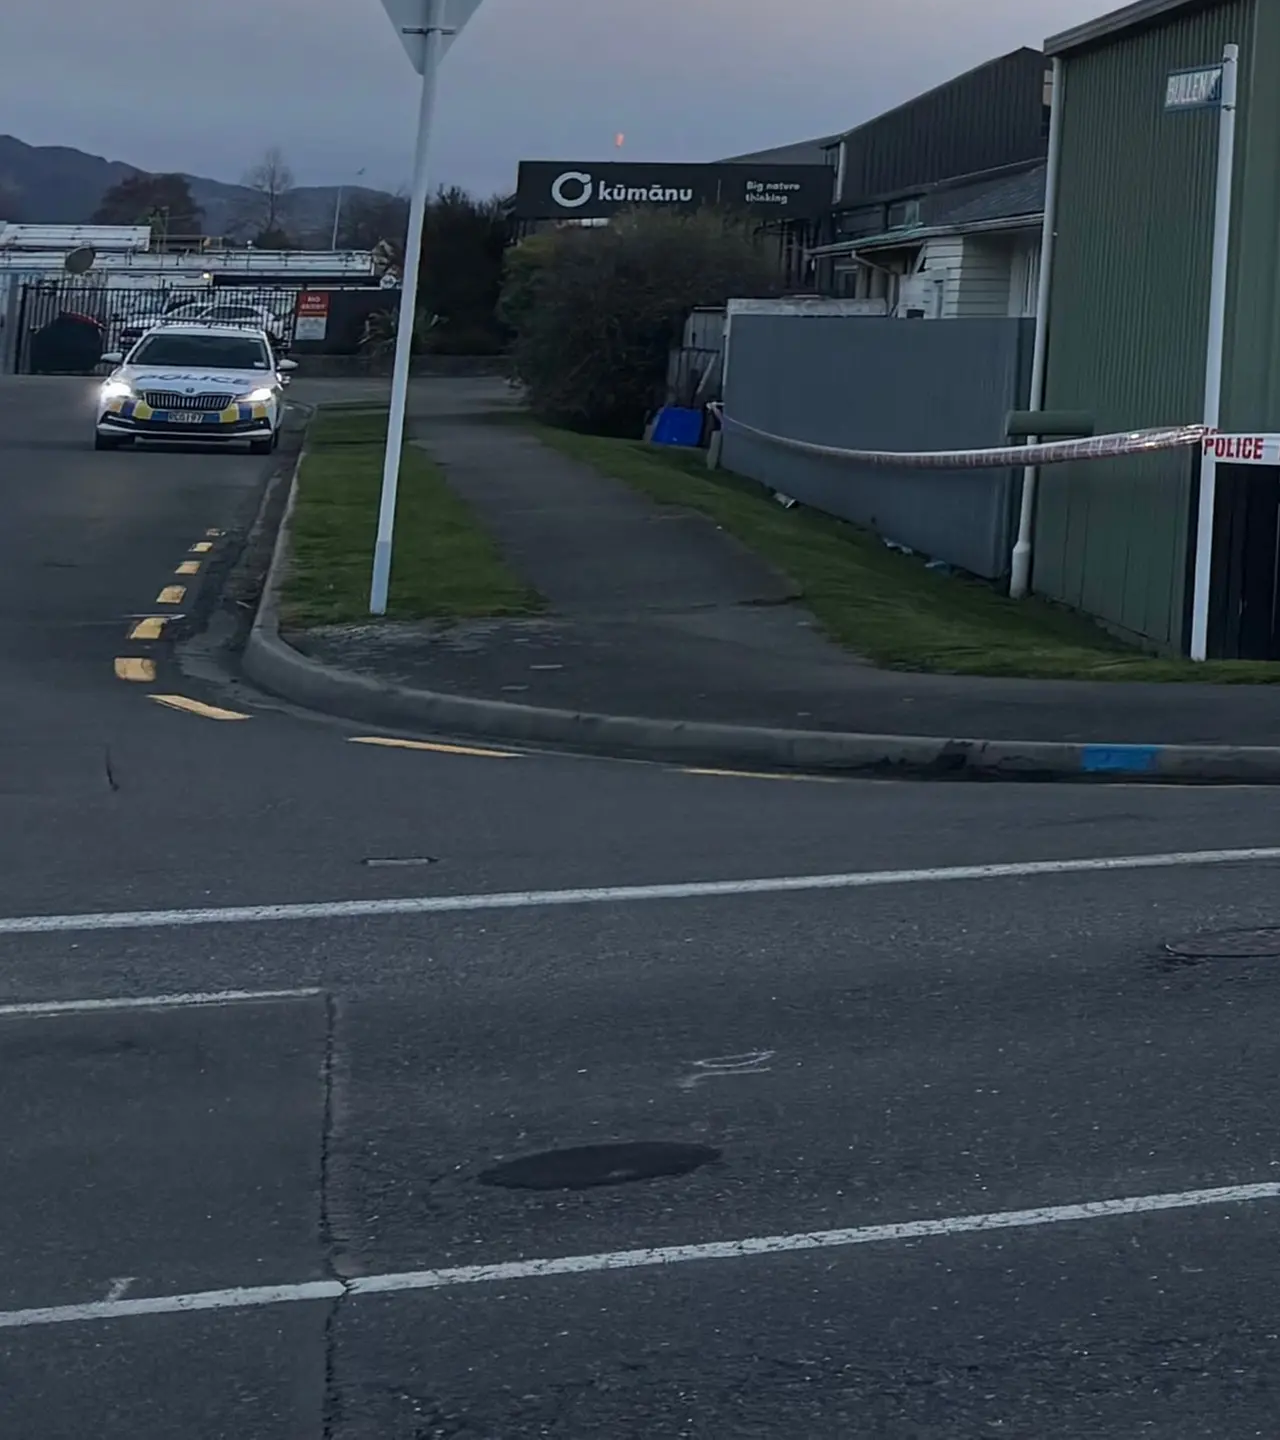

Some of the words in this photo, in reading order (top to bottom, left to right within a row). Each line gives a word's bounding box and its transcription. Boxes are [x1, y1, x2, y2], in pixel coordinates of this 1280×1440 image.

[598, 180, 693, 202] kūmānu
[746, 181, 763, 192] Big
[745, 192, 788, 204] thinking
[136, 373, 250, 385] POLICE
[1203, 438, 1264, 459] POLICE
